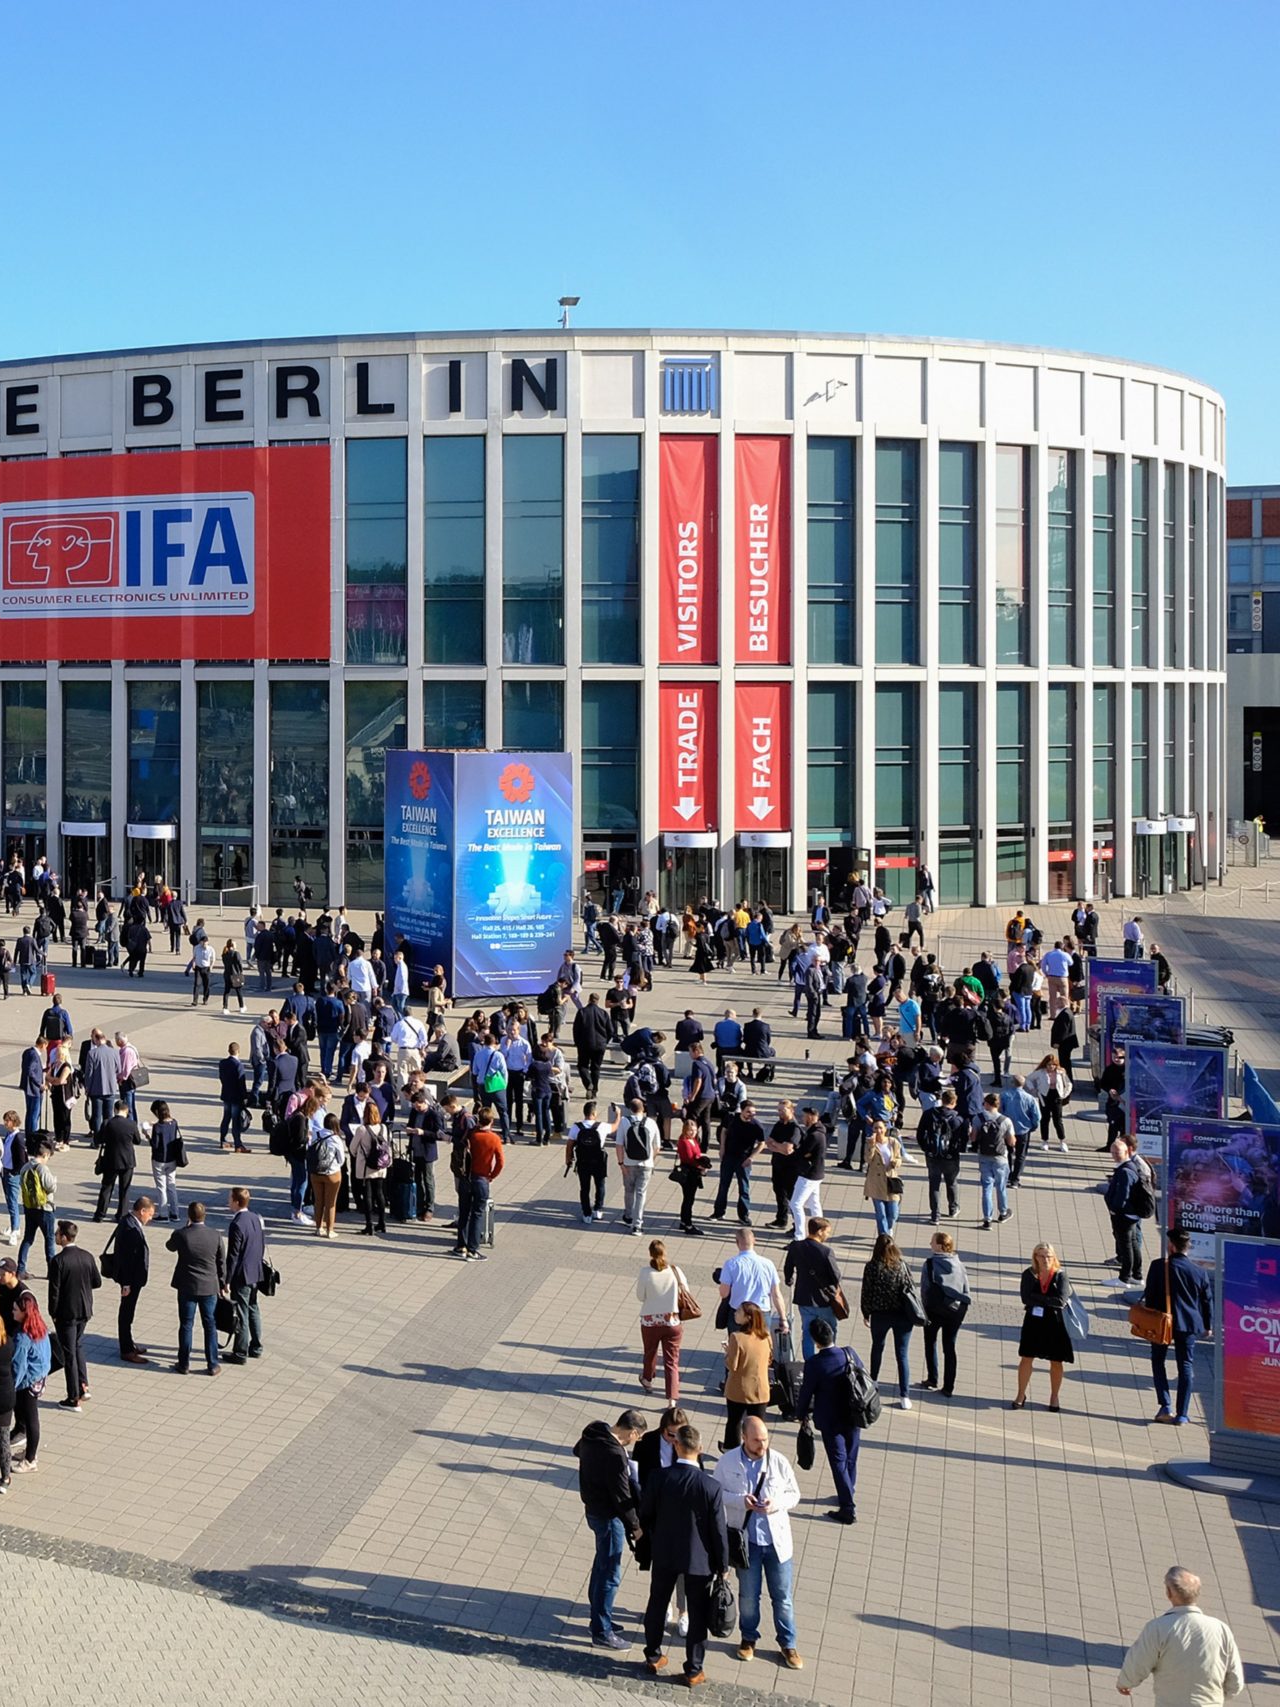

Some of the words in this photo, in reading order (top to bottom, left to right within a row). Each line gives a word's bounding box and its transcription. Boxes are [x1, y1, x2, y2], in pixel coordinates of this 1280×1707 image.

[133, 358, 558, 427] BERLIN
[126, 507, 248, 587] IFA
[749, 503, 769, 652] BESUCHER
[678, 520, 698, 653] VISITORS
[2, 595, 72, 605] CONSUMER
[76, 593, 166, 604] ELECTRONICS
[170, 591, 249, 602] UNLIMITED
[678, 692, 698, 788] TRADE
[752, 717, 772, 788] FACH
[401, 805, 437, 824] TAIWAN
[485, 809, 545, 825] TAIWAN
[402, 822, 437, 836] EXCELLENCE
[487, 827, 545, 838] EXCELLENCE
[468, 843, 481, 852] The
[483, 843, 500, 852] Best
[534, 842, 562, 851] Taiwan
[1181, 1201, 1201, 1212] IoT,
[1204, 1204, 1232, 1215] more
[1235, 1207, 1260, 1217] than
[1181, 1211, 1244, 1227] connecting
[1181, 1220, 1216, 1232] things
